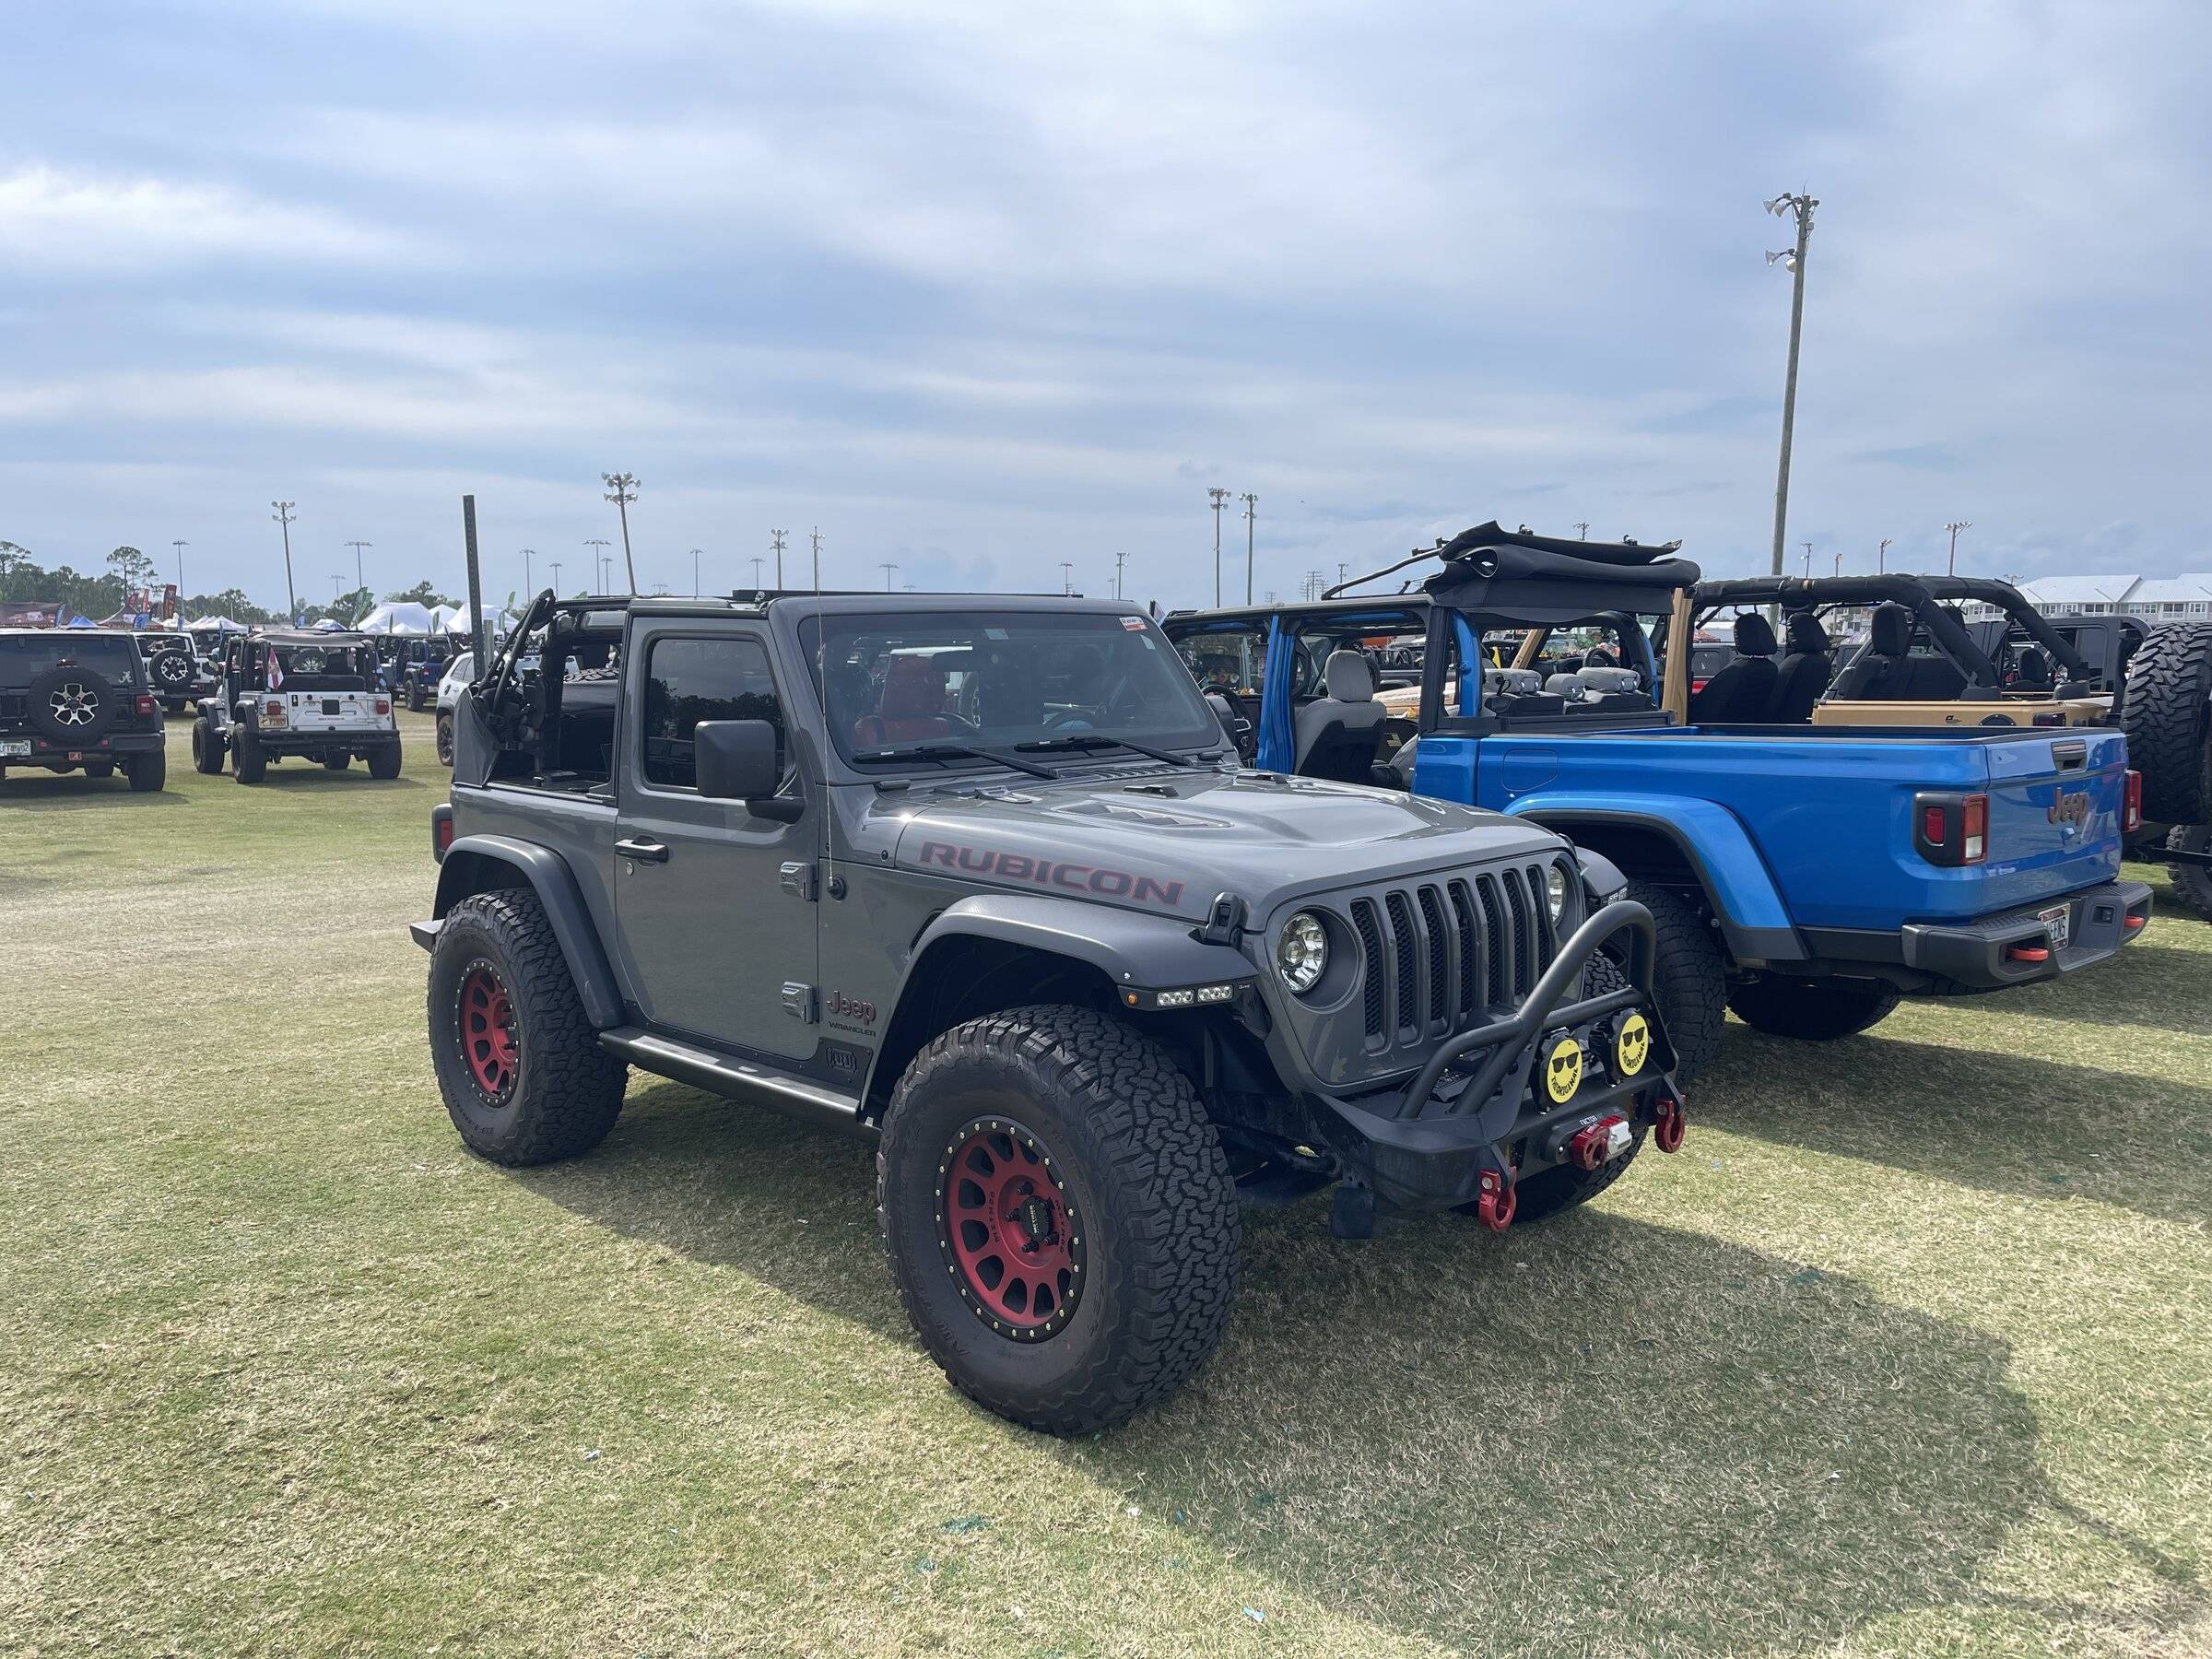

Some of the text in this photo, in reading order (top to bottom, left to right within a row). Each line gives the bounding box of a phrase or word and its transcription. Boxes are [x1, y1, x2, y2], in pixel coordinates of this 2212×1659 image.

[2048, 786, 2088, 827] Jeep
[919, 841, 1185, 907] RUBICON
[827, 990, 876, 1025] Jeep
[829, 1020, 877, 1038] WRANGLER
